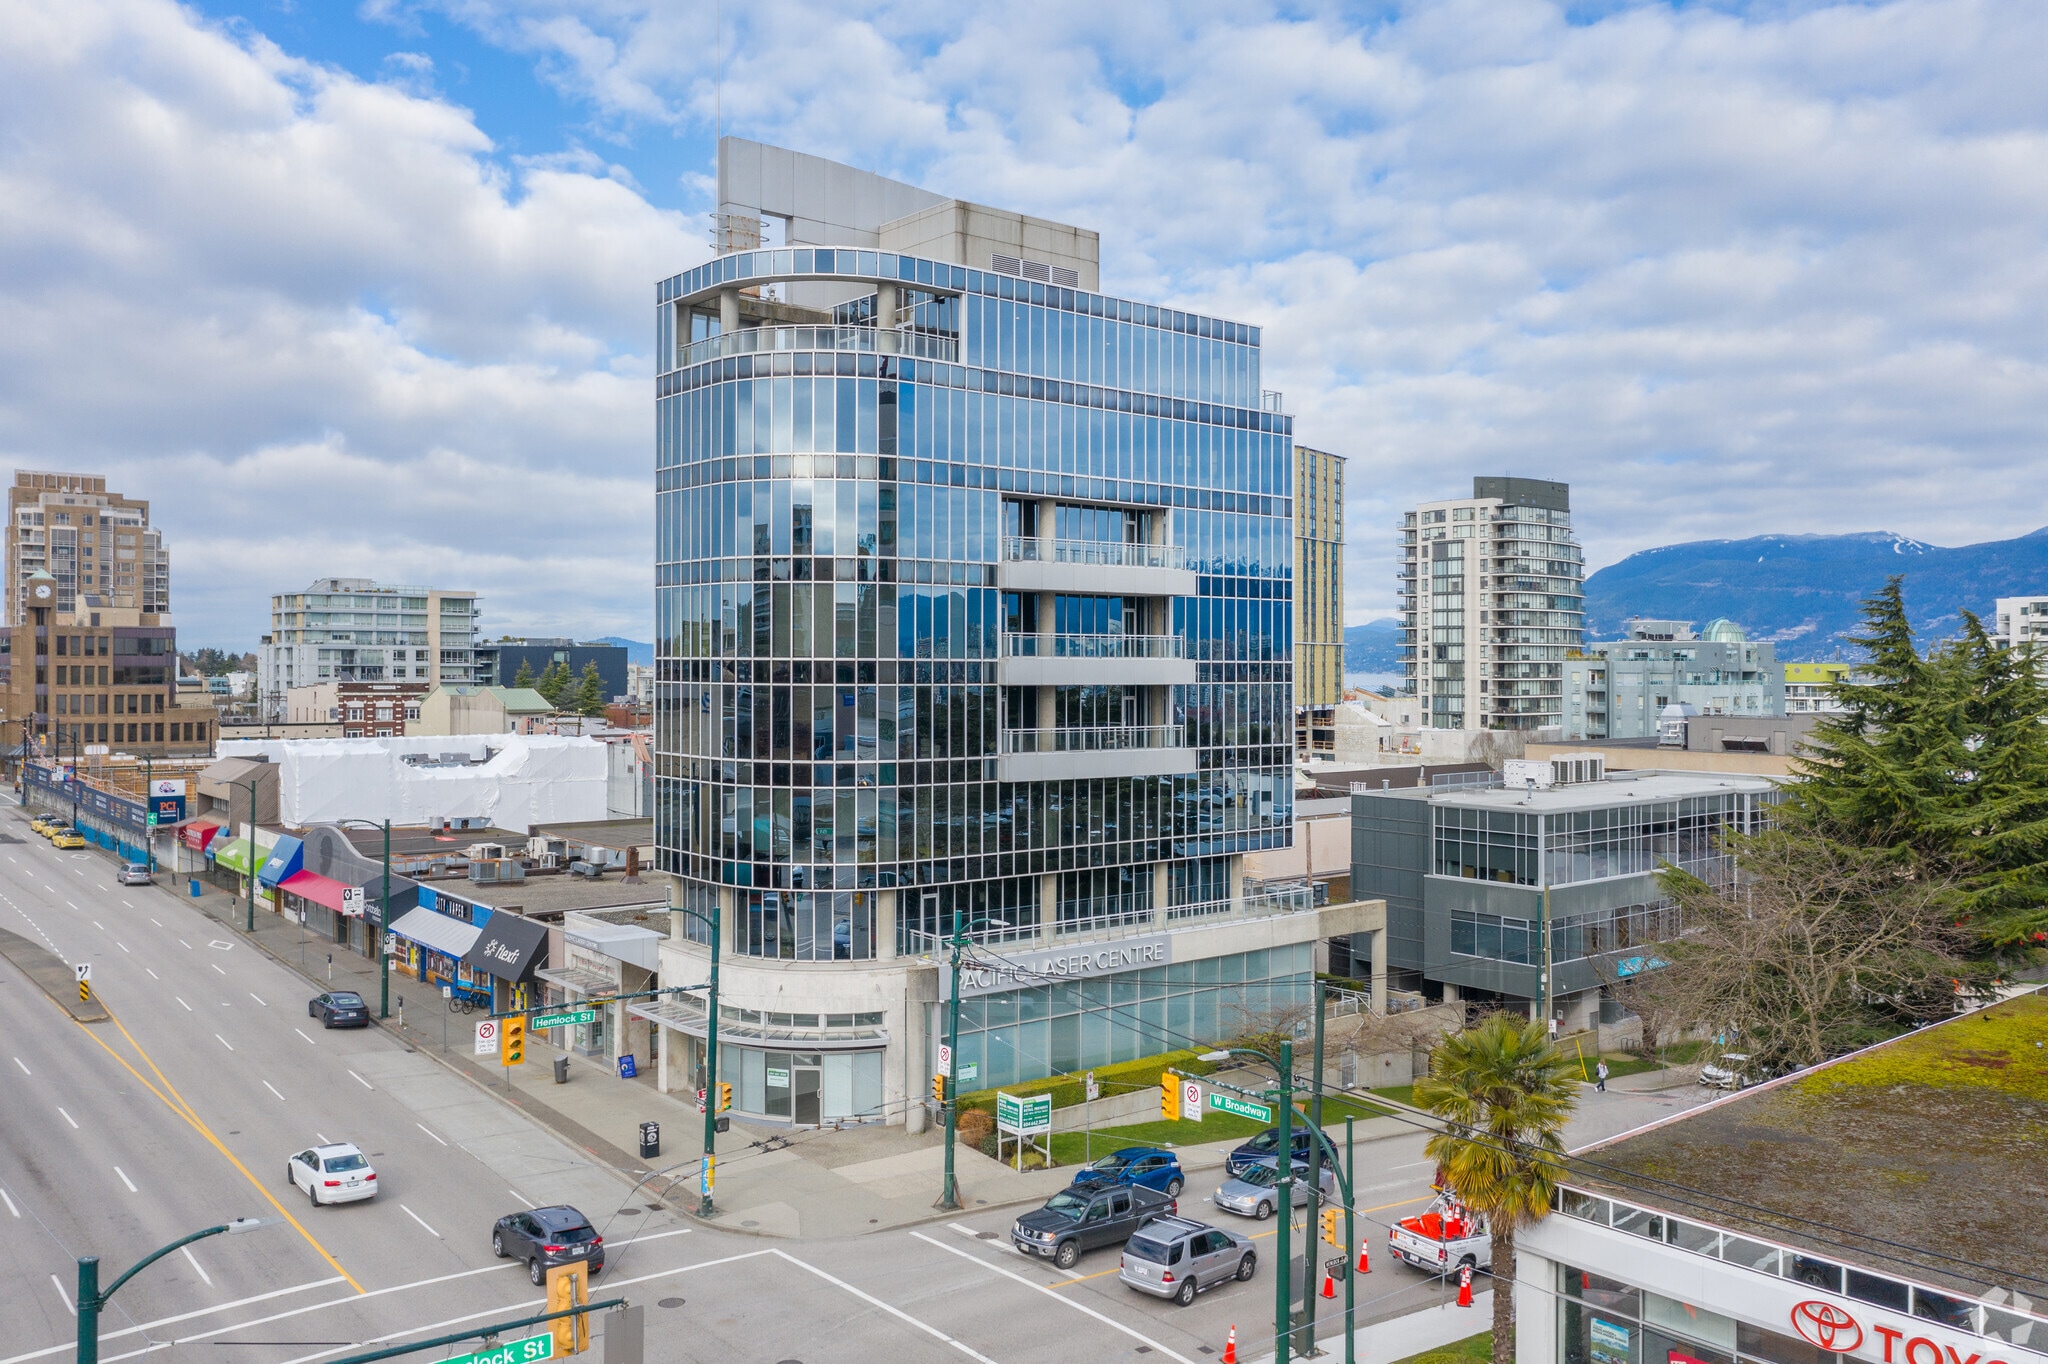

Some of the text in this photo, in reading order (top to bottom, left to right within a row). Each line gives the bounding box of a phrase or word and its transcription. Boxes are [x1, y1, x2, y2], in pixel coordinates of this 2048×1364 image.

[159, 801, 177, 811] PCI
[435, 896, 447, 912] CITY
[494, 944, 520, 965] flexfi
[957, 942, 1165, 992] PACIFIC LASER CENTRE
[536, 1012, 591, 1028] Hemlock St
[1213, 1096, 1267, 1120] W Broadway
[466, 1340, 545, 1364] lock St
[1874, 1325, 2009, 1364] TOY
